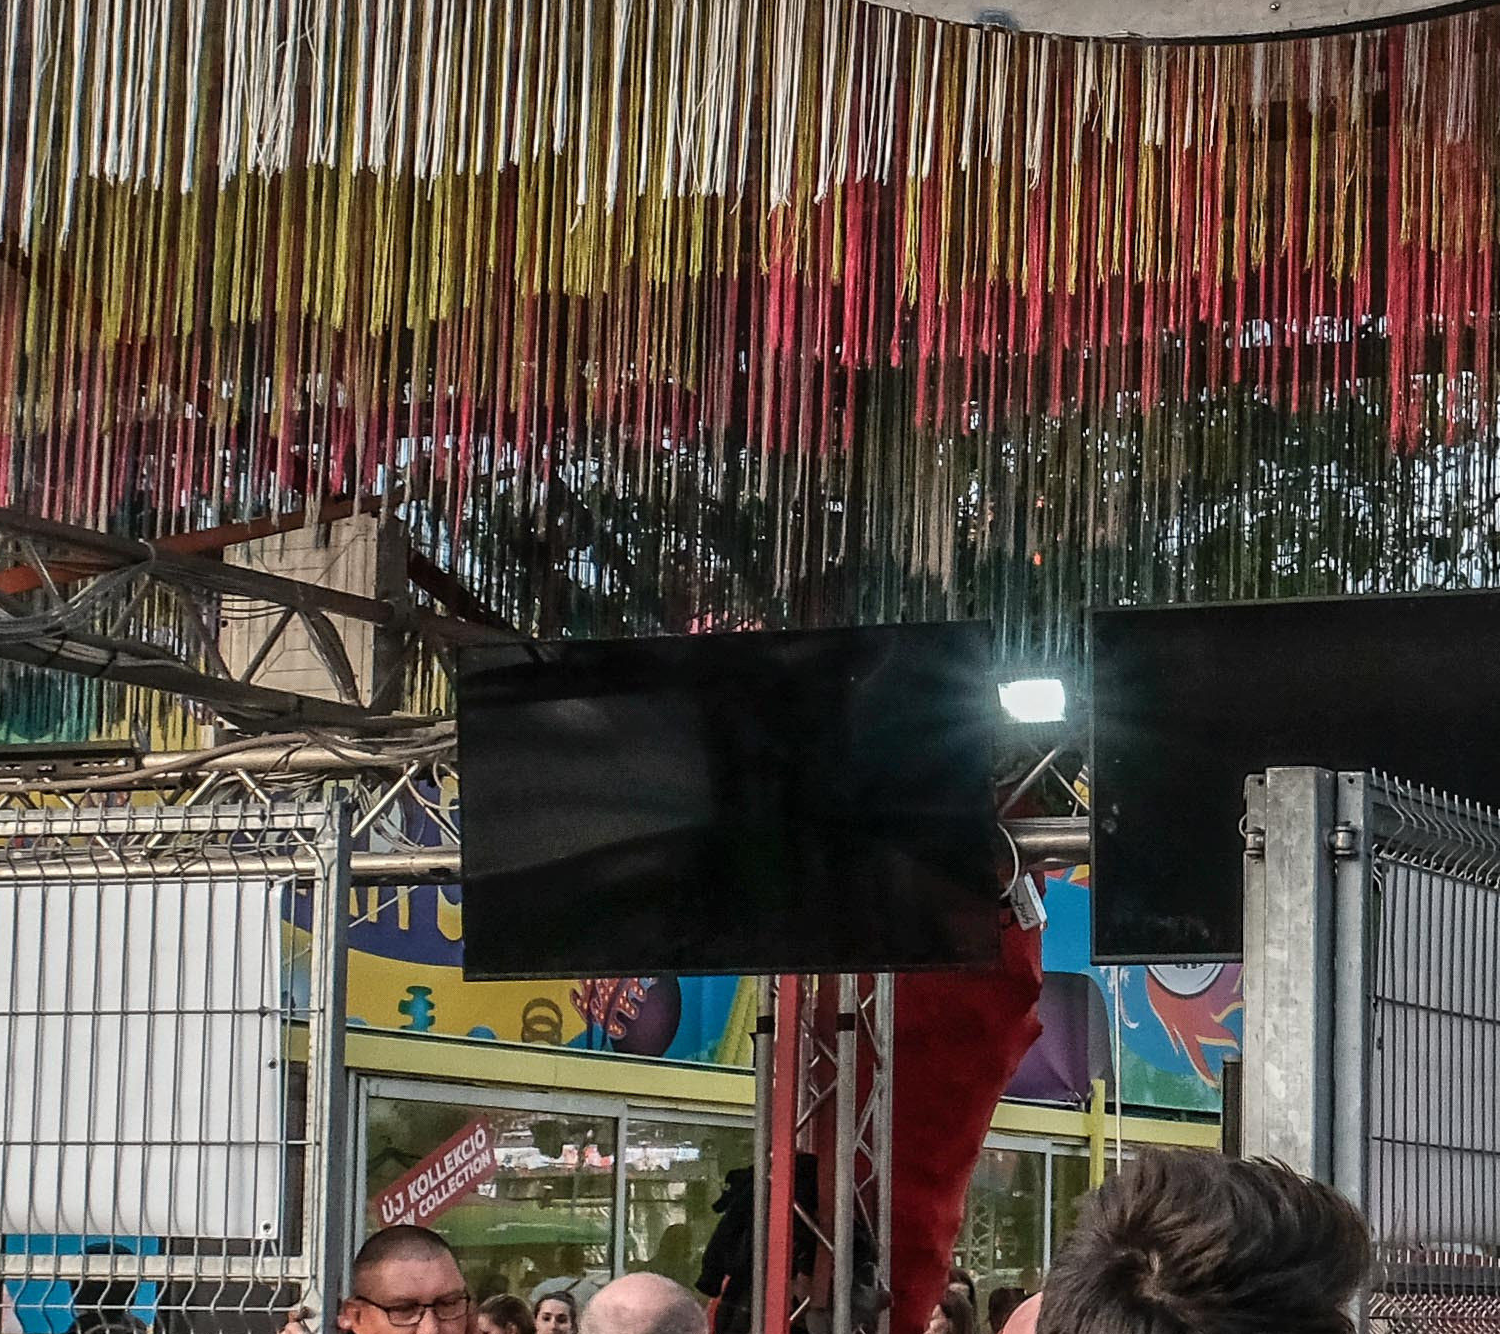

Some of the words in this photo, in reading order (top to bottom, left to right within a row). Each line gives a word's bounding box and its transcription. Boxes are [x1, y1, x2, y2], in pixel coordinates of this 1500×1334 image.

[381, 1192, 405, 1224] ÚJ
[407, 1123, 487, 1204] KOLLEKCIÓ
[418, 1148, 492, 1217] COLLECTION
